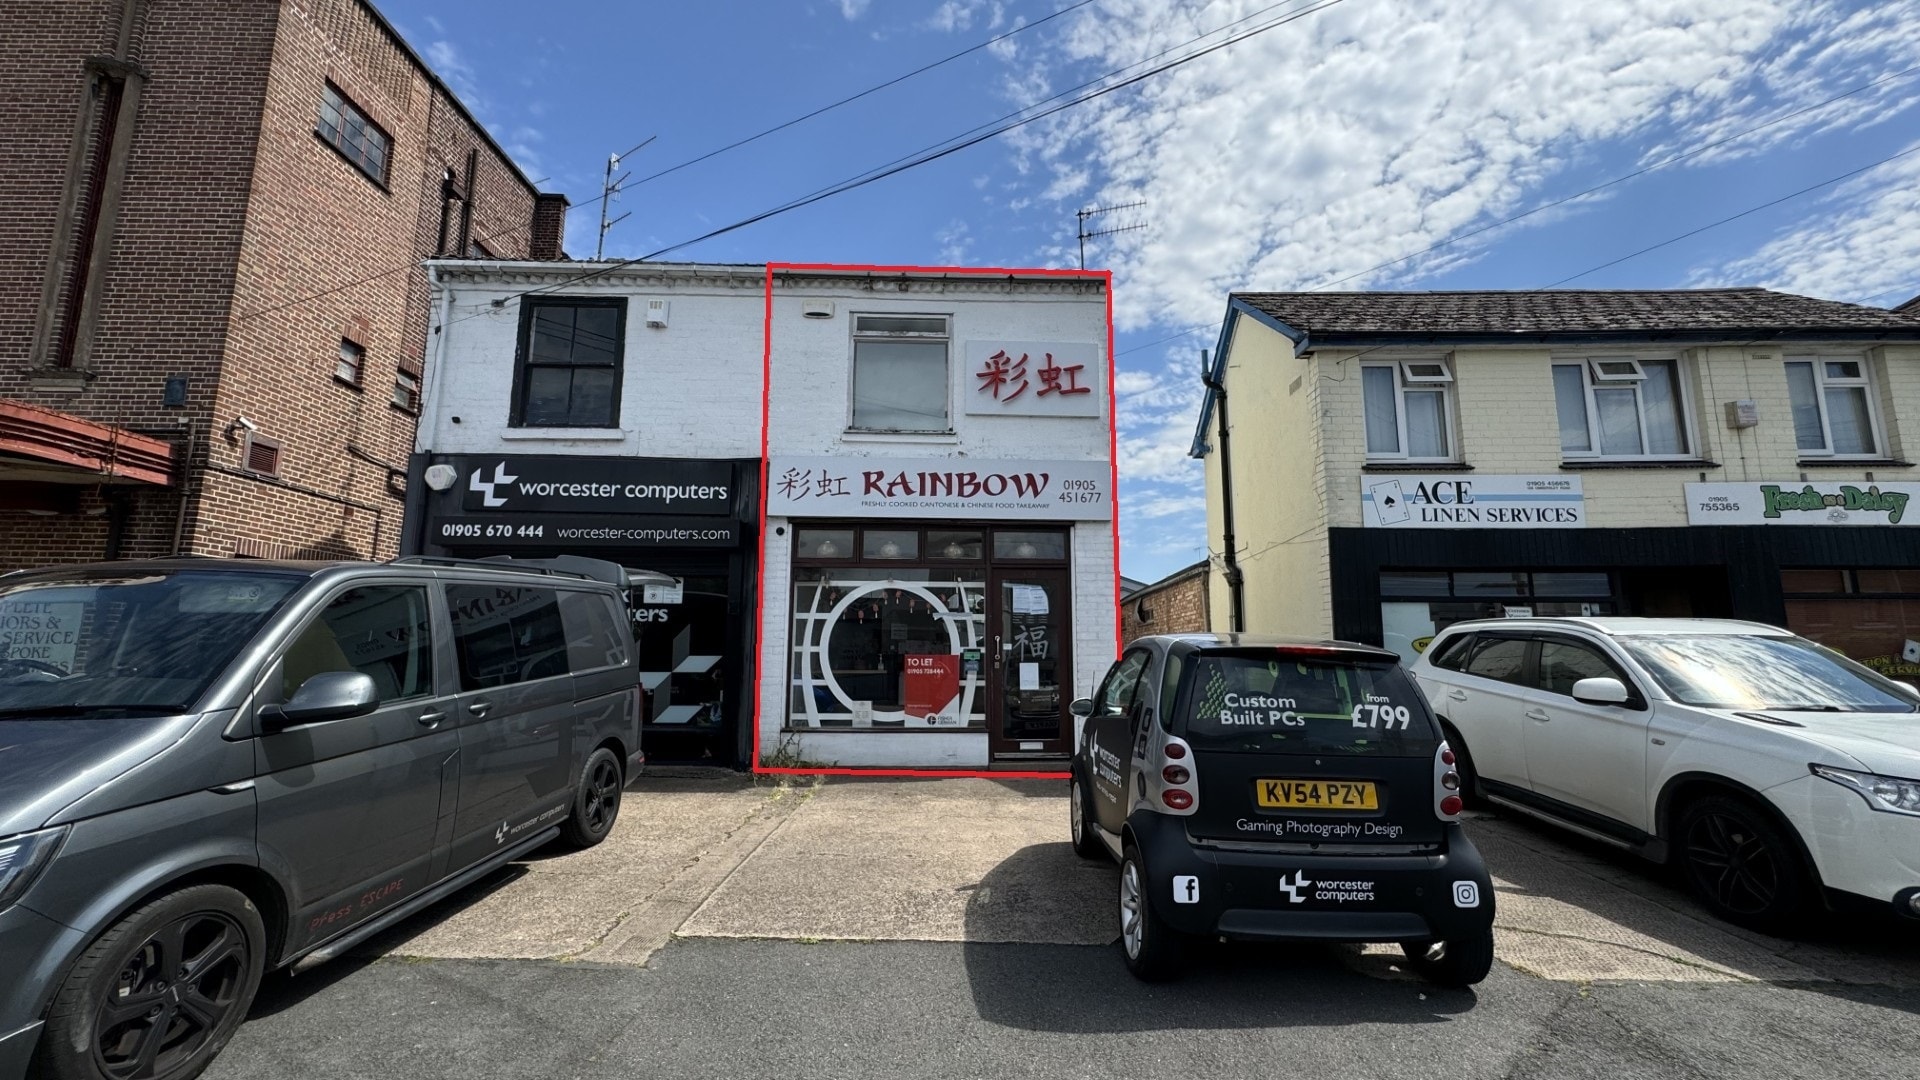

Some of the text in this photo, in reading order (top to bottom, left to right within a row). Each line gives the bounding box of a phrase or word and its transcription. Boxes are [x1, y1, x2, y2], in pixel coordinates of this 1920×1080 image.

[976, 350, 1091, 402] 彩虹
[519, 482, 728, 505] worcester computers
[776, 467, 851, 502] 彩虹
[862, 470, 1050, 499] RAINBOW
[1063, 480, 1096, 490] 01905
[1411, 480, 1475, 504] ACE
[1059, 492, 1101, 503] 451677
[1700, 503, 1740, 511] 755365
[1760, 485, 1824, 519] Fresh
[1839, 485, 1910, 524] Daisy
[1421, 507, 1578, 523] LINEN SERVICES
[442, 524, 730, 543] 01905 670 444 worcester-computers.com
[1013, 625, 1049, 661] 福
[907, 658, 933, 667] TO LET
[1224, 693, 1297, 708] Custom
[1366, 693, 1390, 703] from
[1220, 710, 1306, 726] Built PCs
[1351, 703, 1411, 730] £799
[1265, 782, 1366, 805] KV54 PZY
[1236, 818, 1403, 838] Gaming Photography Design
[360, 878, 404, 907] ESCAPE
[1315, 880, 1375, 903] worcester computers
